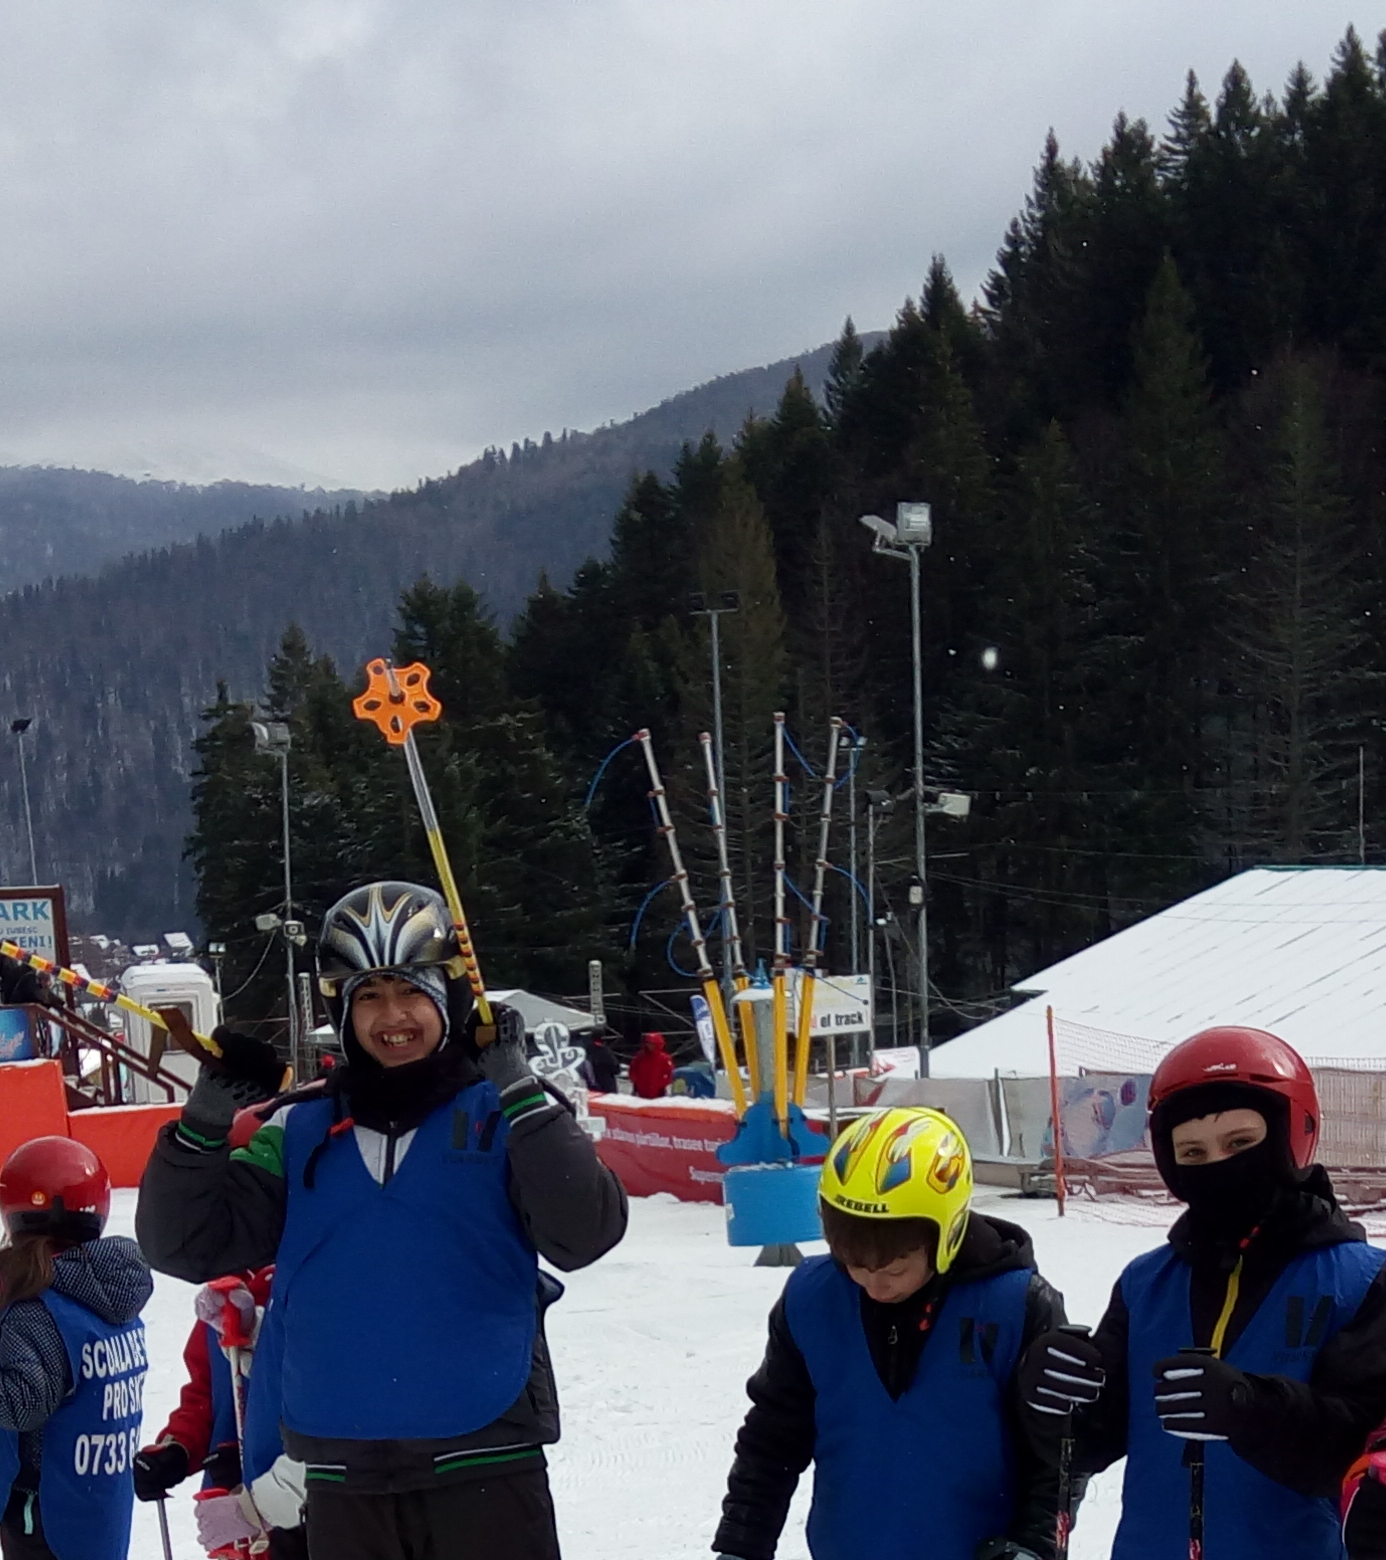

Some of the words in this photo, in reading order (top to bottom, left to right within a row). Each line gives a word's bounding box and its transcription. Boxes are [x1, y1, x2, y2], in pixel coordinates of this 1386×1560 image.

[835, 1011, 864, 1026] track
[835, 1193, 889, 1213] REBELL
[102, 1380, 128, 1421] PRO
[75, 1431, 126, 1476] 0733
